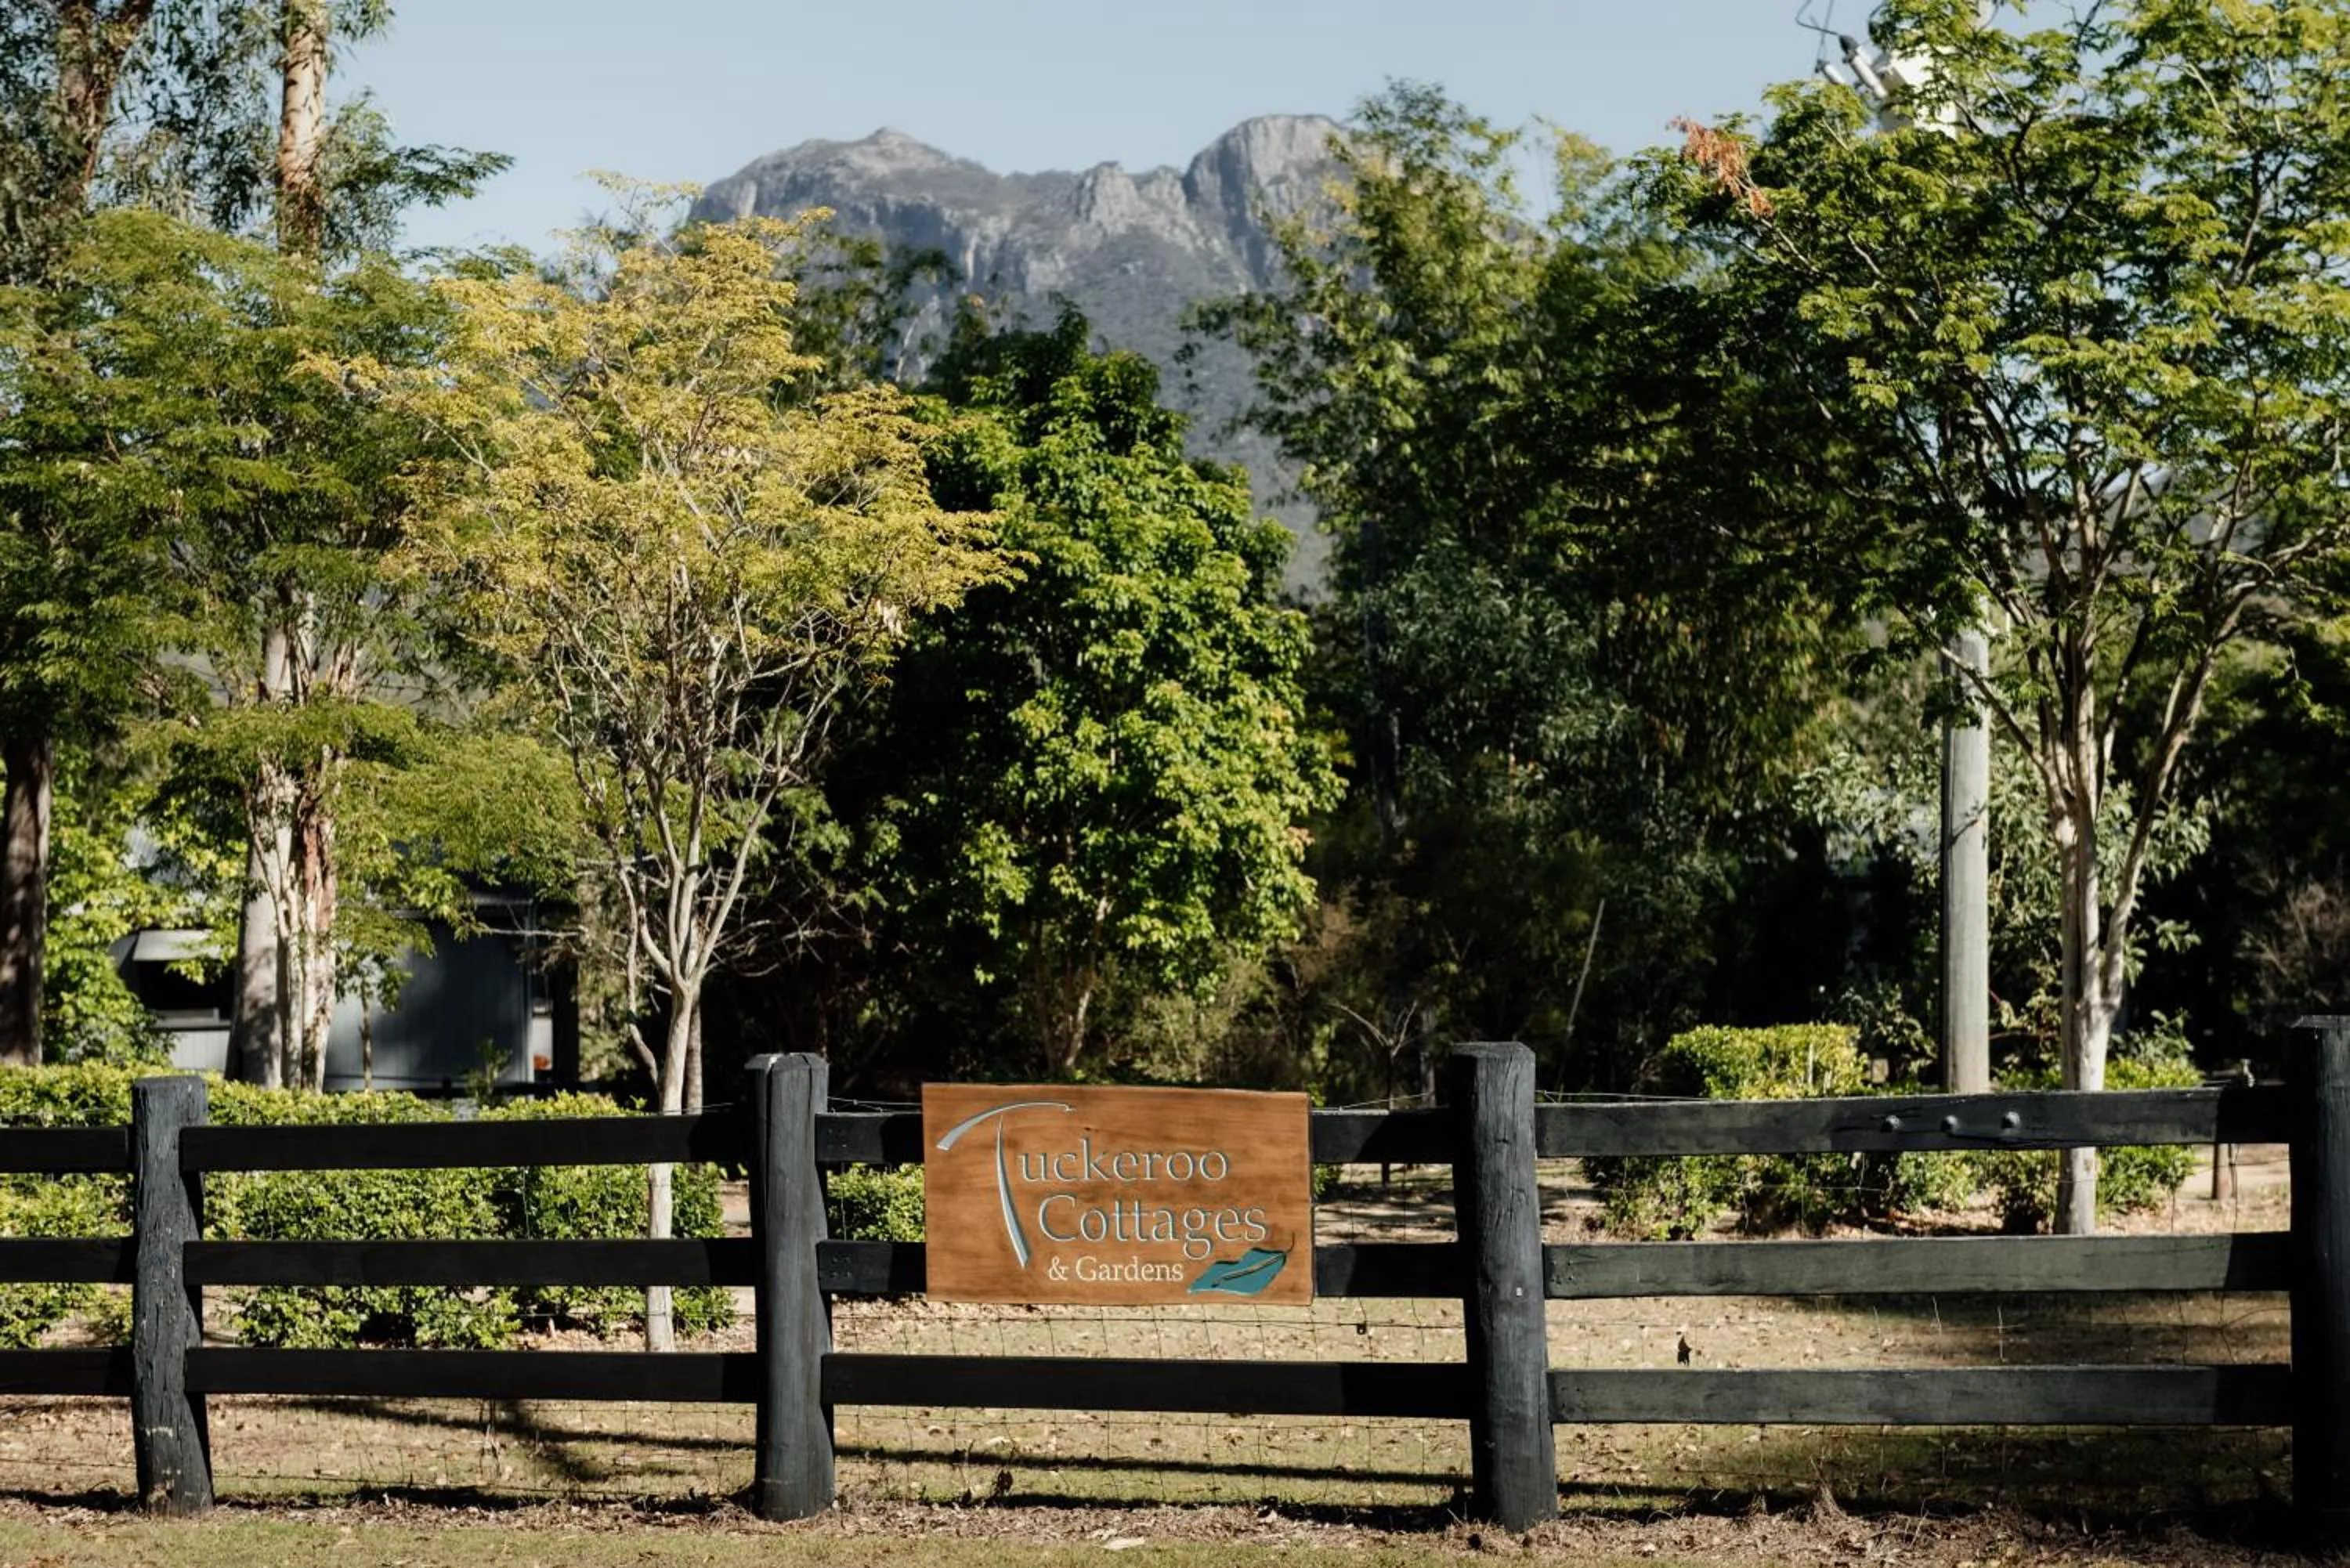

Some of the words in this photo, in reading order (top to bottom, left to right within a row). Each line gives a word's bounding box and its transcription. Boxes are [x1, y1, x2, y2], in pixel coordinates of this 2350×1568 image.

[936, 1100, 1229, 1269] Tuckeroo
[1038, 1194, 1268, 1260] Cottages
[1048, 1256, 1068, 1283] &
[1076, 1255, 1184, 1283] Gardens
